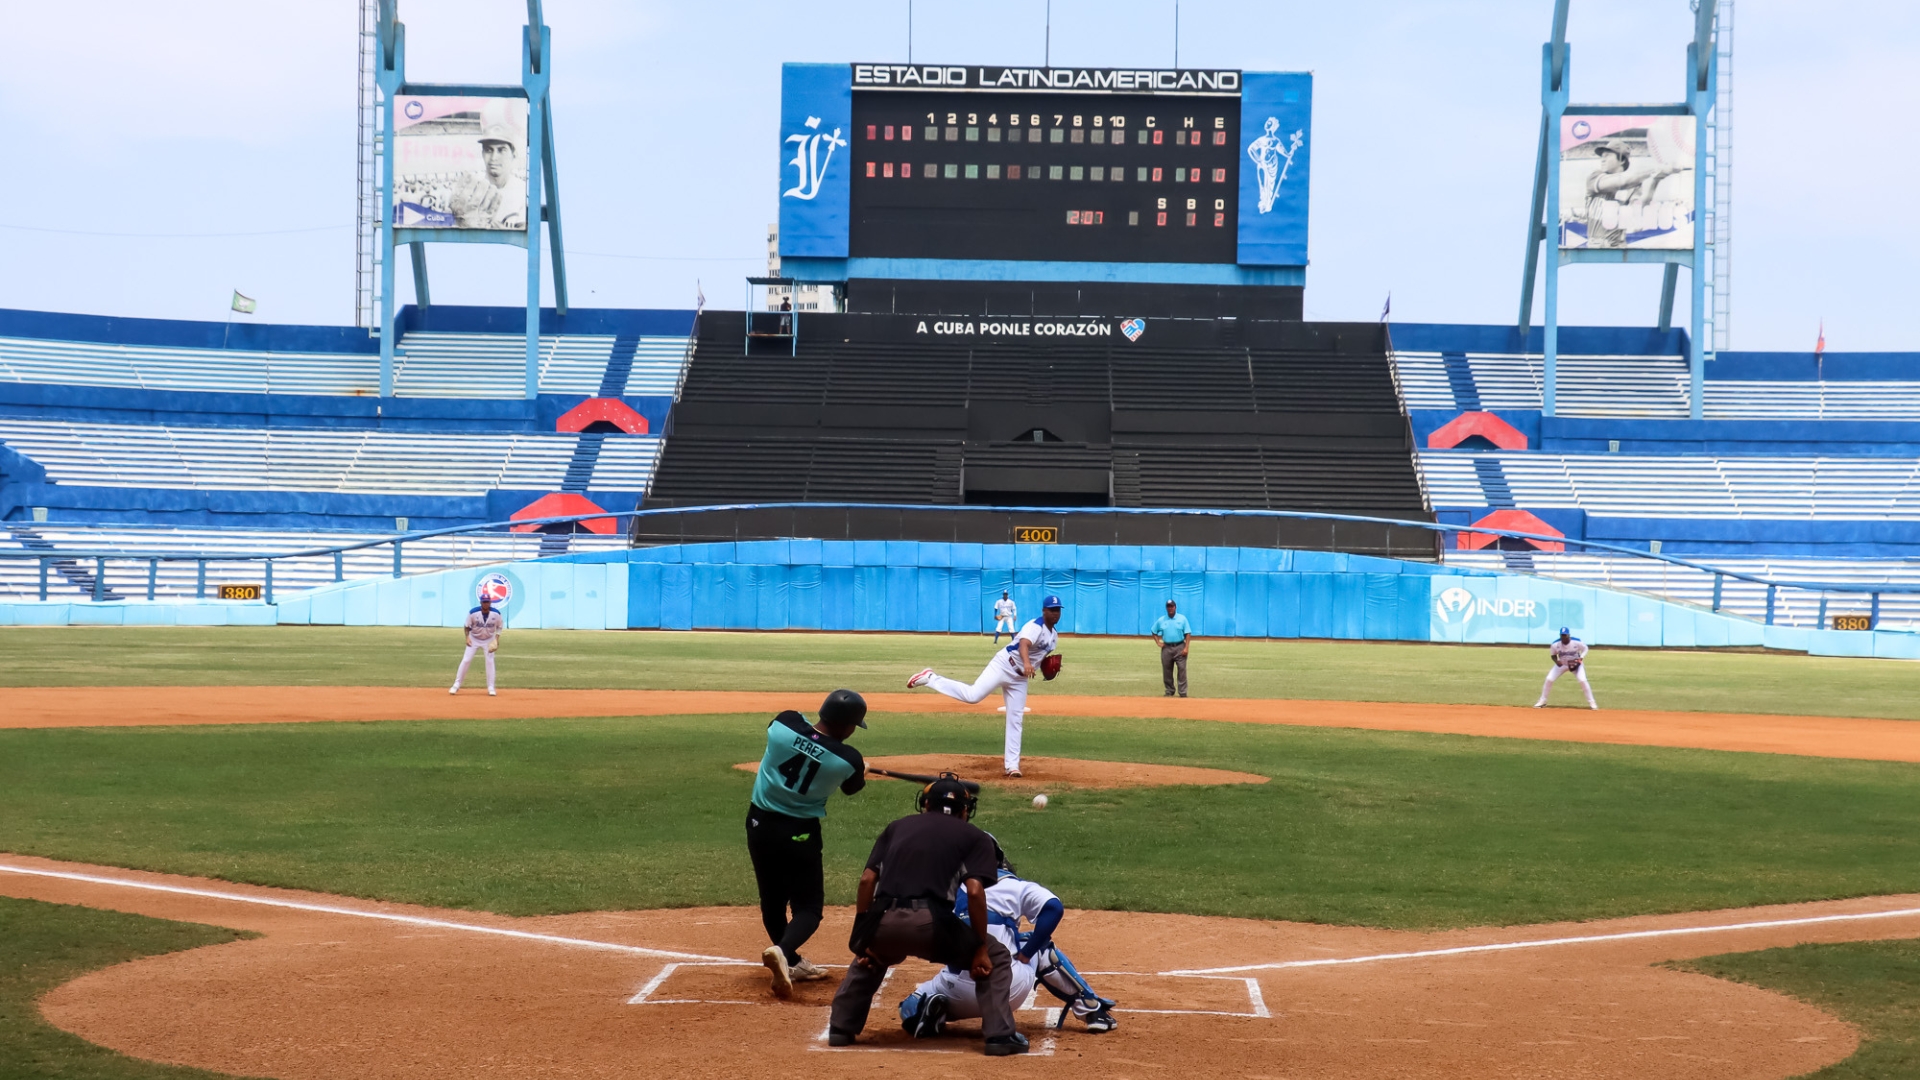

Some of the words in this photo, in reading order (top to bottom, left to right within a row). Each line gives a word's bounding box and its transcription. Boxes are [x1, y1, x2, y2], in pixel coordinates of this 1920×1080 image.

[855, 65, 967, 85] ESTADIO
[979, 68, 1238, 89] LATINOAMERICANO
[927, 112, 934, 124] 1
[947, 113, 957, 125] 2
[968, 113, 977, 125] 3
[988, 113, 997, 125] 4
[1010, 114, 1020, 126] 5
[1030, 114, 1040, 126] 6
[1053, 115, 1063, 126] 7
[1073, 115, 1082, 127] 8
[1093, 115, 1103, 127] 9
[1109, 116, 1125, 128] 10
[1146, 116, 1156, 128] C
[1184, 116, 1193, 128] H
[1214, 117, 1224, 128] E
[1157, 198, 1167, 209] S
[1186, 198, 1196, 210] B
[426, 214, 445, 222] Cuba
[1070, 210, 1104, 224] 2:07
[1214, 213, 1224, 227] 2
[916, 321, 928, 334] A
[933, 321, 975, 335] CUBA
[980, 322, 1030, 336] PONLE
[1034, 320, 1111, 336] CORAZÓN
[1020, 529, 1052, 542] 400
[225, 587, 255, 599] 380
[1476, 598, 1537, 618] INDER
[1837, 617, 1869, 630] 380
[792, 736, 825, 760] PEREZ
[778, 752, 822, 796] 41
